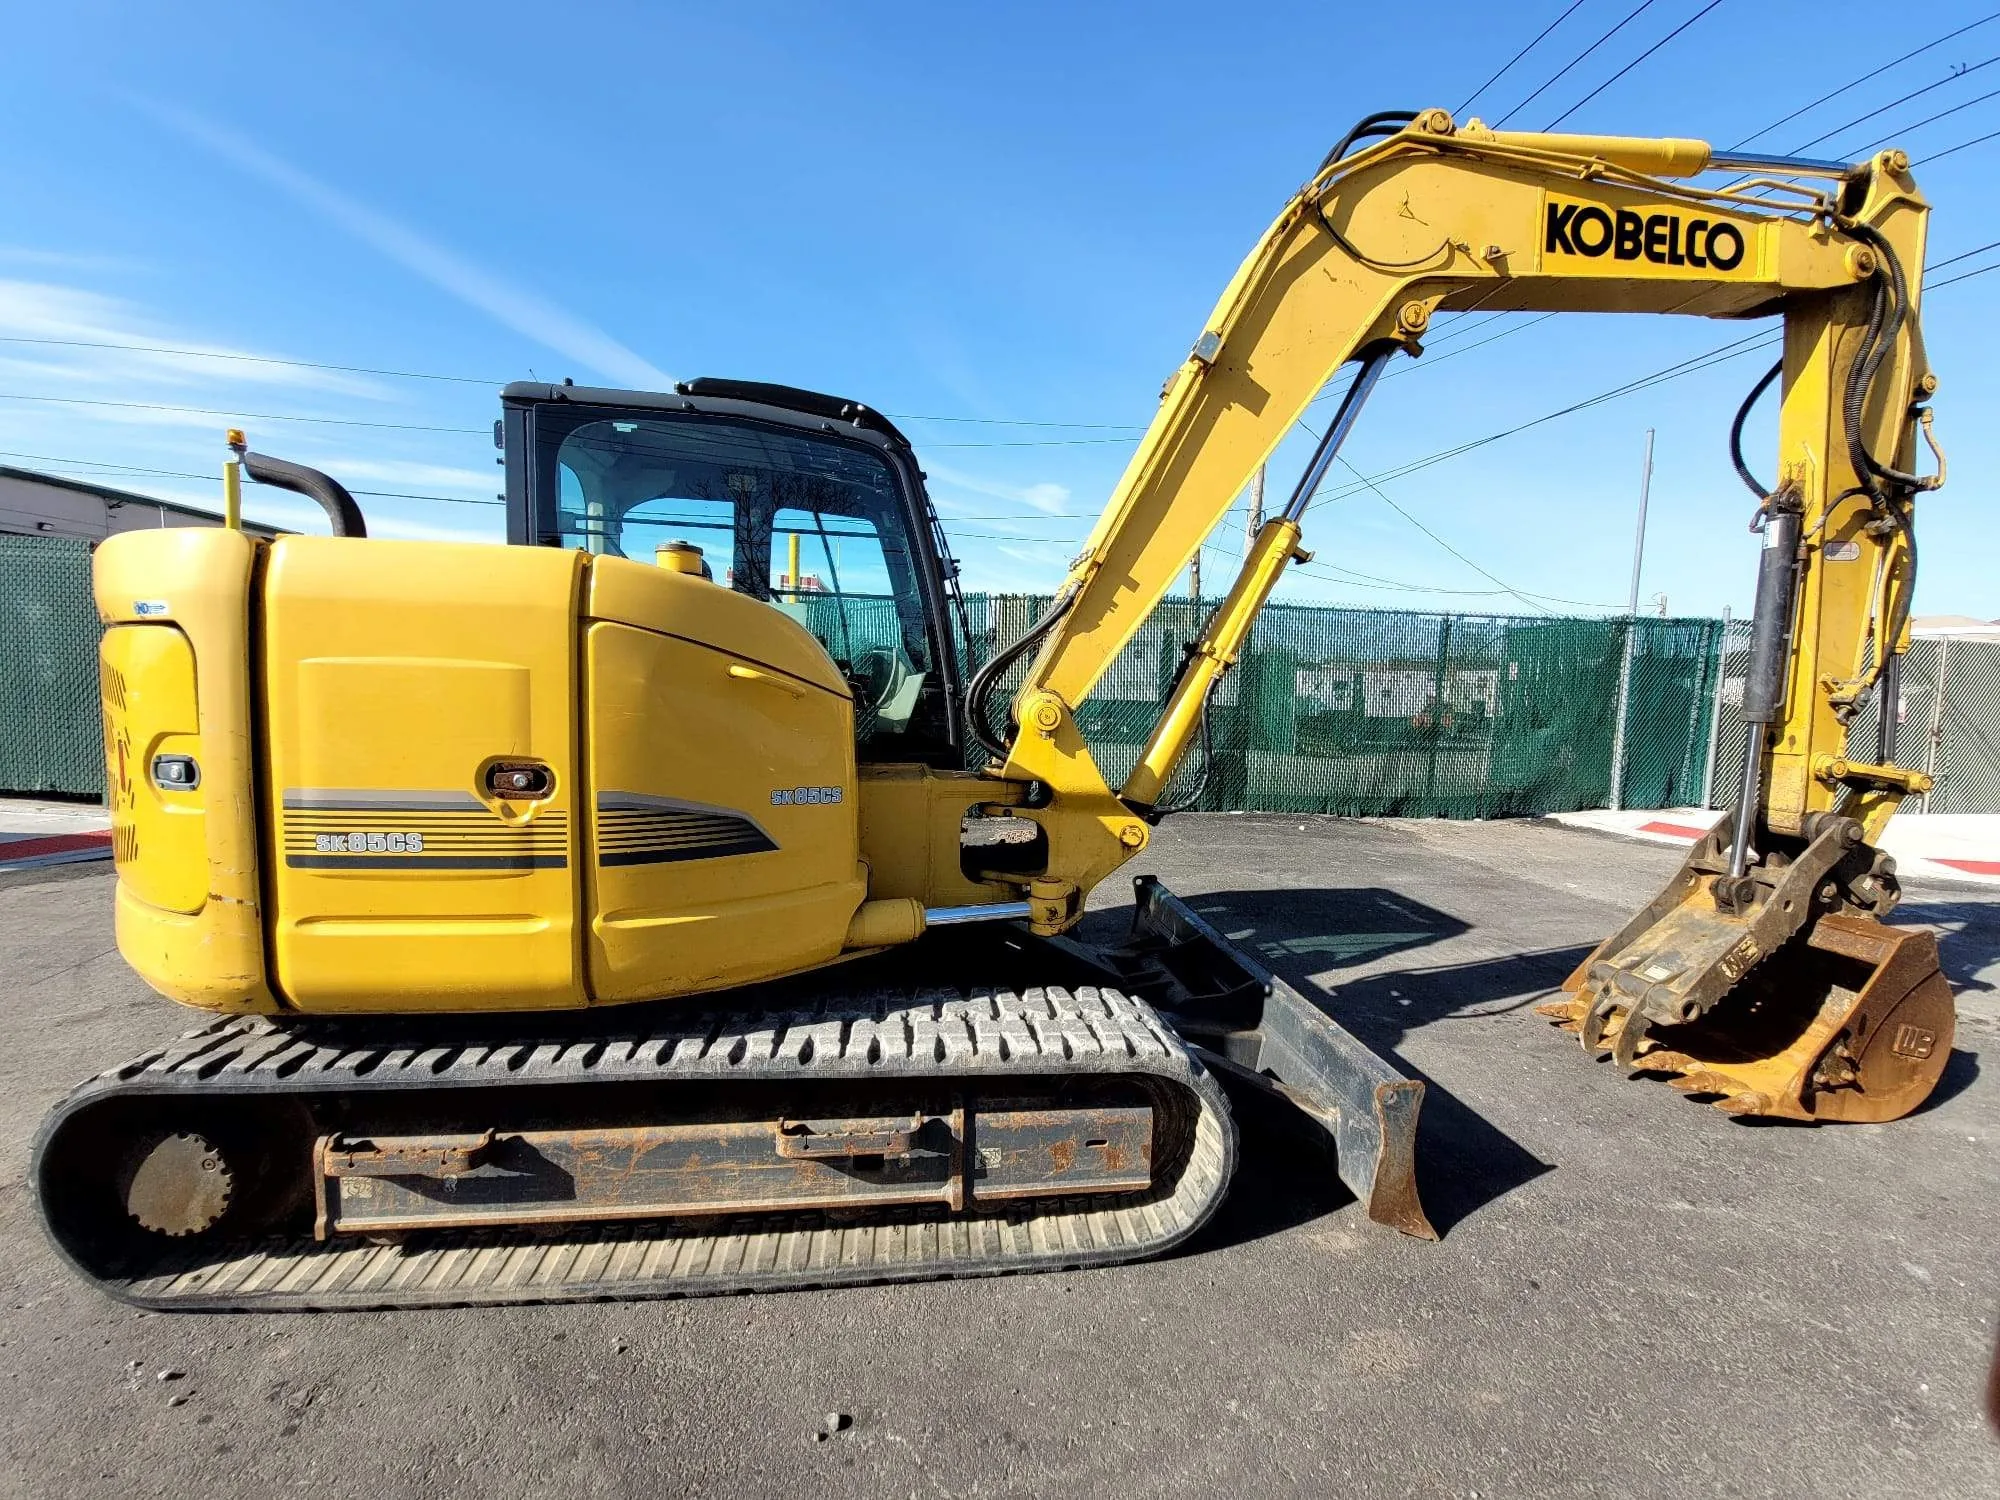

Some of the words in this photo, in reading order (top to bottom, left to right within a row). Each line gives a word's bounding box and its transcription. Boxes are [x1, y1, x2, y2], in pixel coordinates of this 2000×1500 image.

[1546, 202, 1745, 271] KOBELCO
[771, 787, 842, 805] SK85CS
[316, 832, 424, 853] SK85CS
